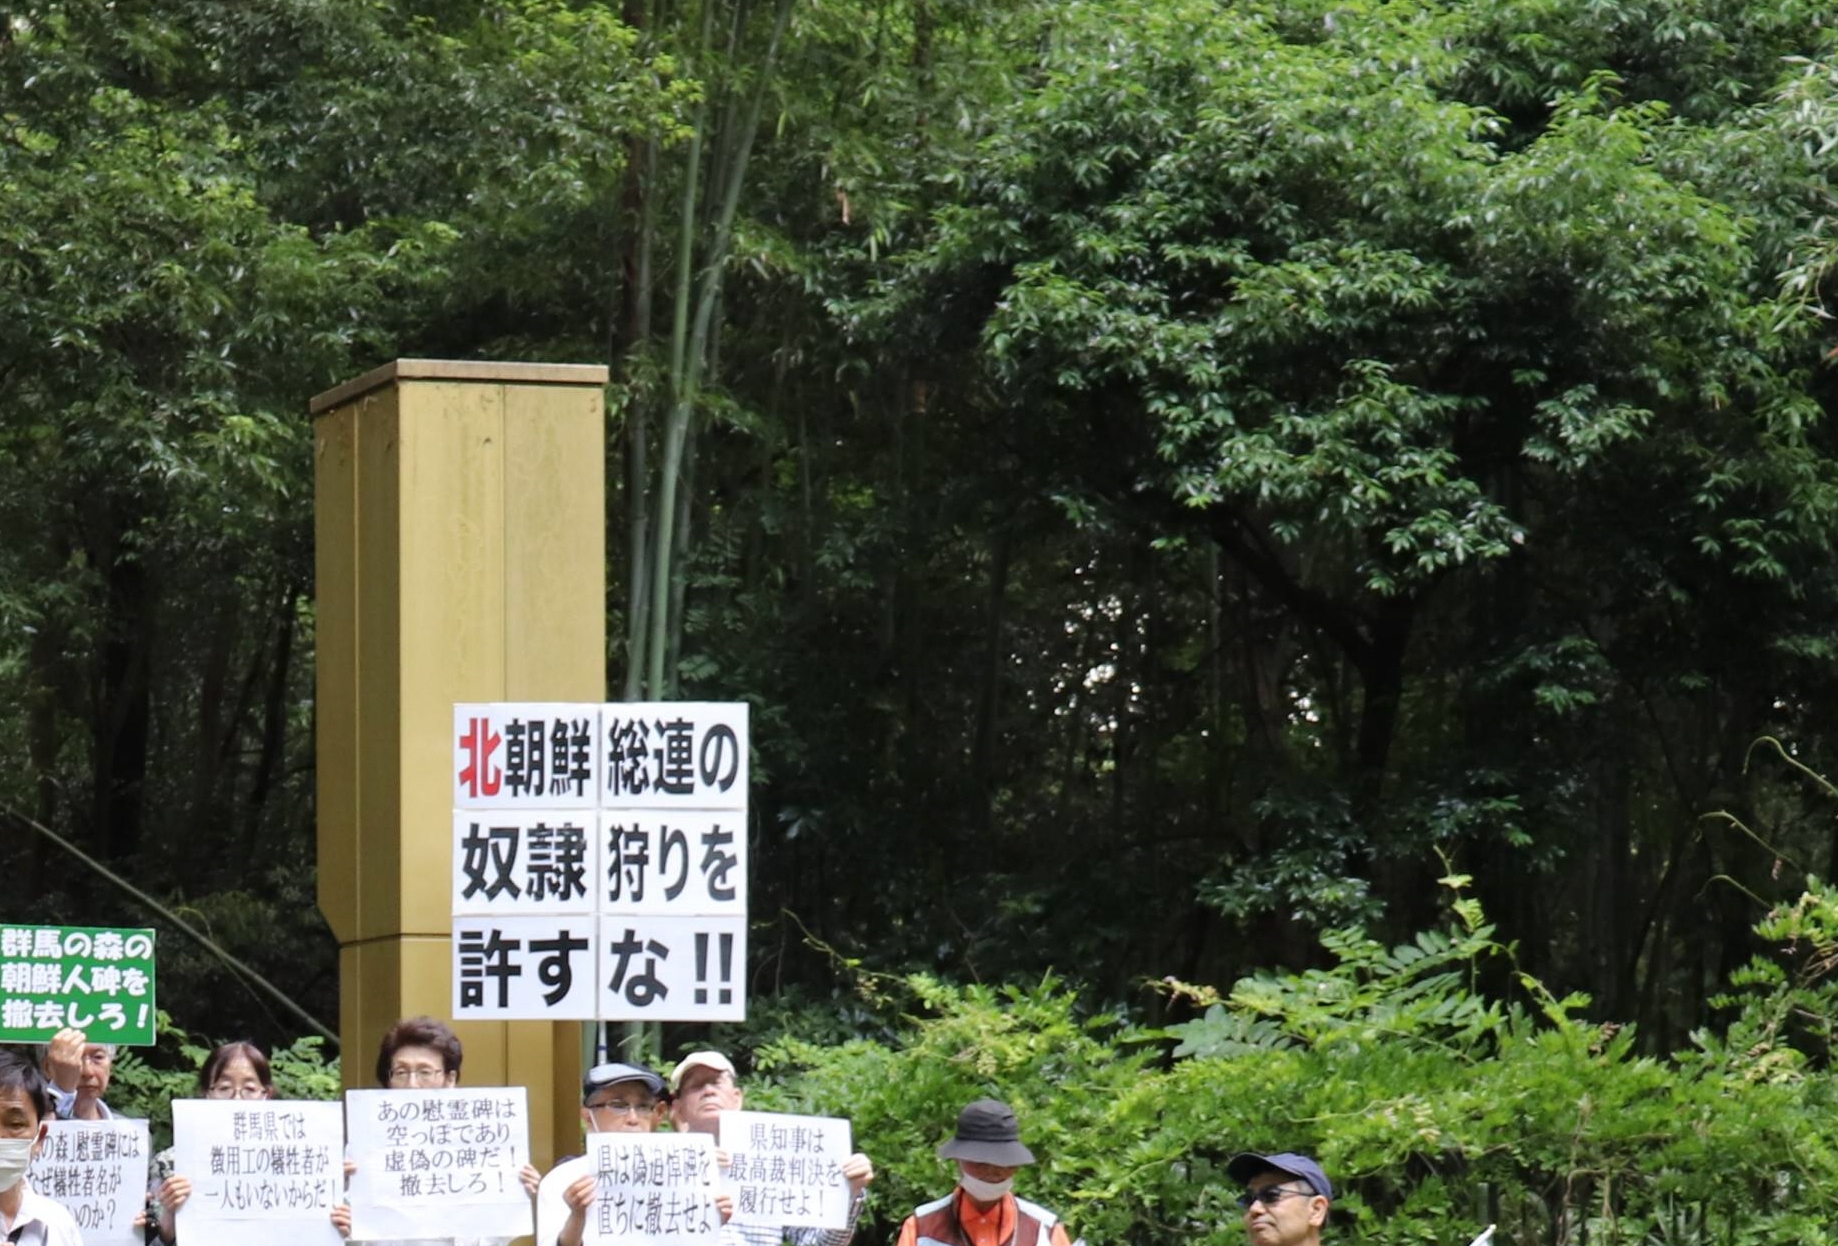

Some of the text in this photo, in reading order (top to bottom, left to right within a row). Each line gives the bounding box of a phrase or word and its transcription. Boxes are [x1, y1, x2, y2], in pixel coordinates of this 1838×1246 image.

[459, 717, 739, 798] 北朝鮮総連の
[461, 822, 737, 902] 奴隷狩りを
[1, 928, 153, 960] 群馬の森の
[1, 962, 150, 996] 朝鮮人碑を
[459, 928, 733, 1008] 許すな!!
[1, 999, 150, 1030] 撤去しろ！
[233, 1111, 306, 1141] 群馬県では
[377, 1098, 517, 1123] あの慰霊碑は
[385, 1122, 510, 1147] 空っぽであり
[750, 1122, 824, 1154] 県知事は
[384, 1146, 516, 1173] 虚偽の碑だ！
[728, 1153, 842, 1187] 最高裁判決を
[399, 1171, 504, 1197] 撤去しろ！
[597, 1191, 711, 1237] 直ちに撤去せよ
[738, 1185, 824, 1217] 履行せよ！
